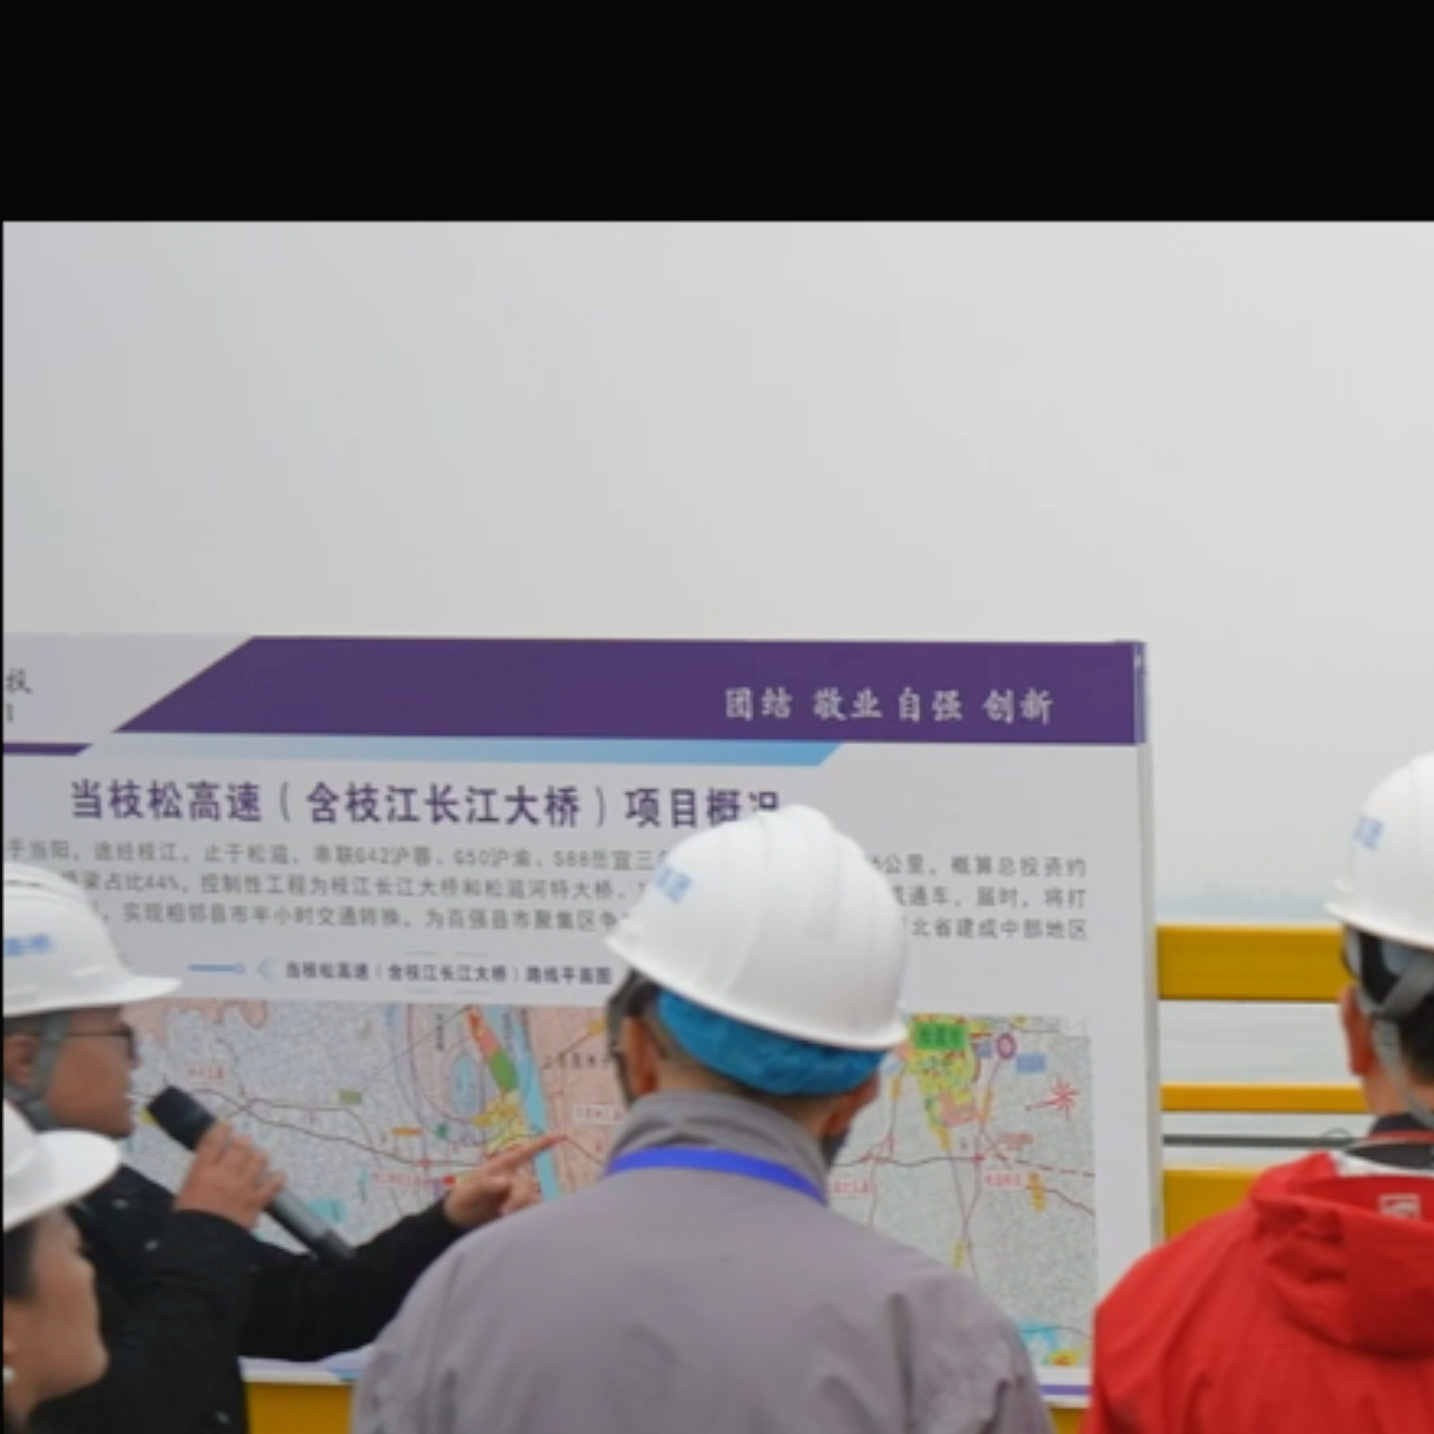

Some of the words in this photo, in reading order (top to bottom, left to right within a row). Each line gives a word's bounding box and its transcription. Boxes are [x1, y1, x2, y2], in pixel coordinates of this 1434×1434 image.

[725, 687, 792, 721] 团结
[813, 688, 883, 722] 敬业
[899, 688, 963, 723] 自强
[983, 690, 1053, 725] 创新
